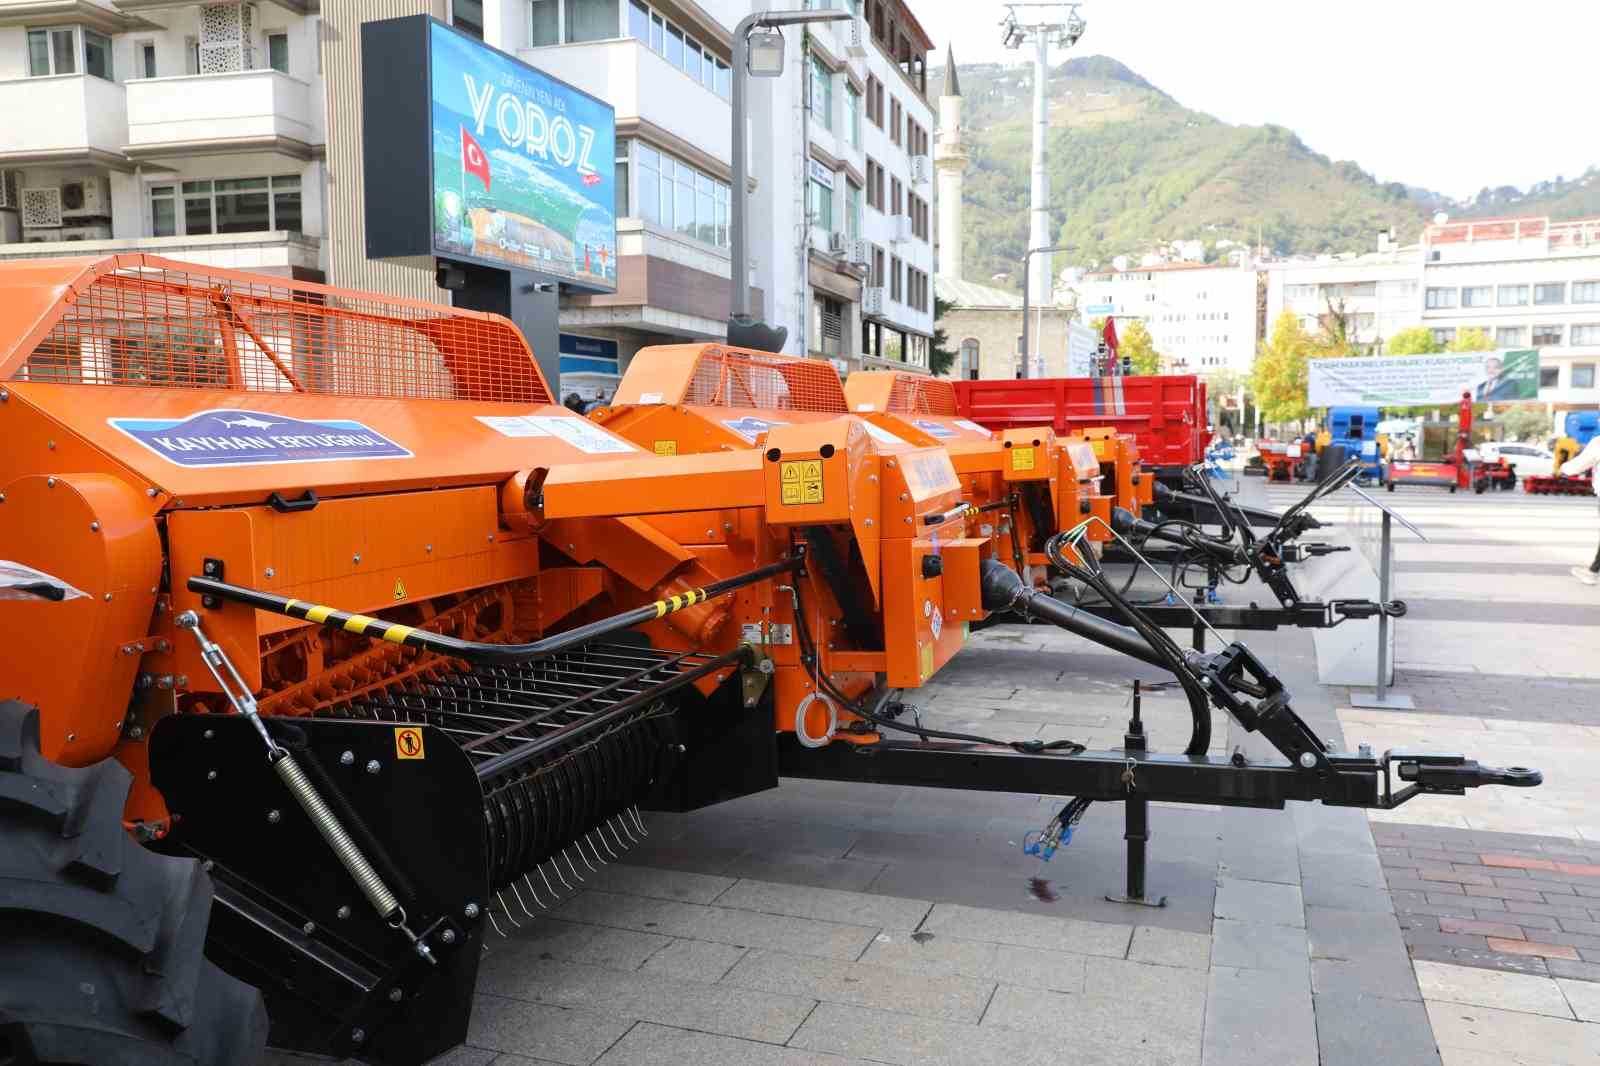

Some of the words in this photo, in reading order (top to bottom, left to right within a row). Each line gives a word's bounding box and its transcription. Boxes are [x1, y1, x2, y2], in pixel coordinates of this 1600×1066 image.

[464, 72, 596, 176] YOROZ
[152, 436, 276, 451] KAYHAN
[270, 433, 386, 449] ERTUĞRUL
